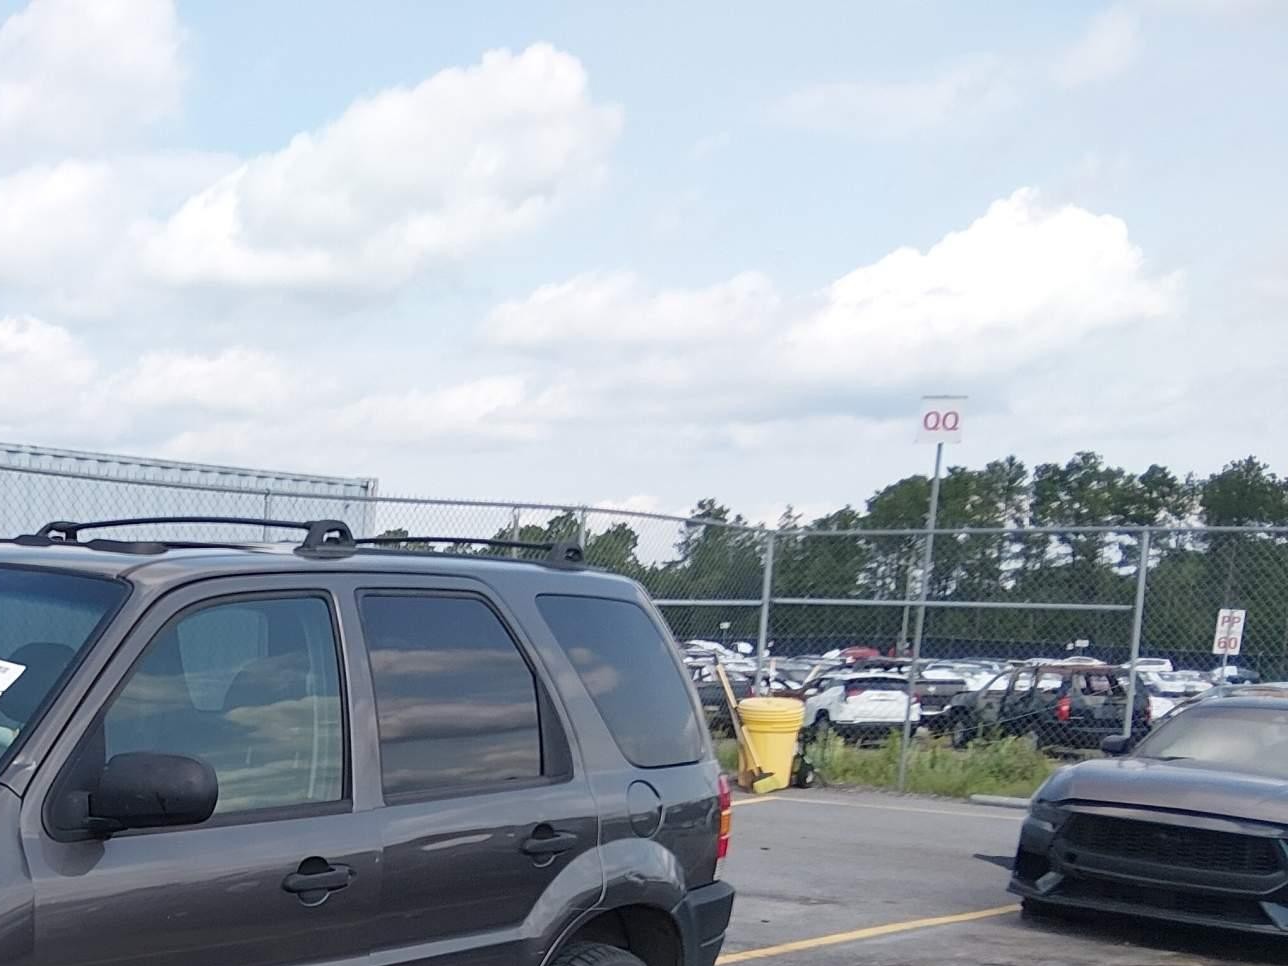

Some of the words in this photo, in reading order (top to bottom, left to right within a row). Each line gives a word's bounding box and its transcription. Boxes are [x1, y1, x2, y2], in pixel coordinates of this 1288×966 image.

[923, 410, 959, 432] QQ
[1220, 615, 1242, 628] PP
[1217, 636, 1238, 650] 60
